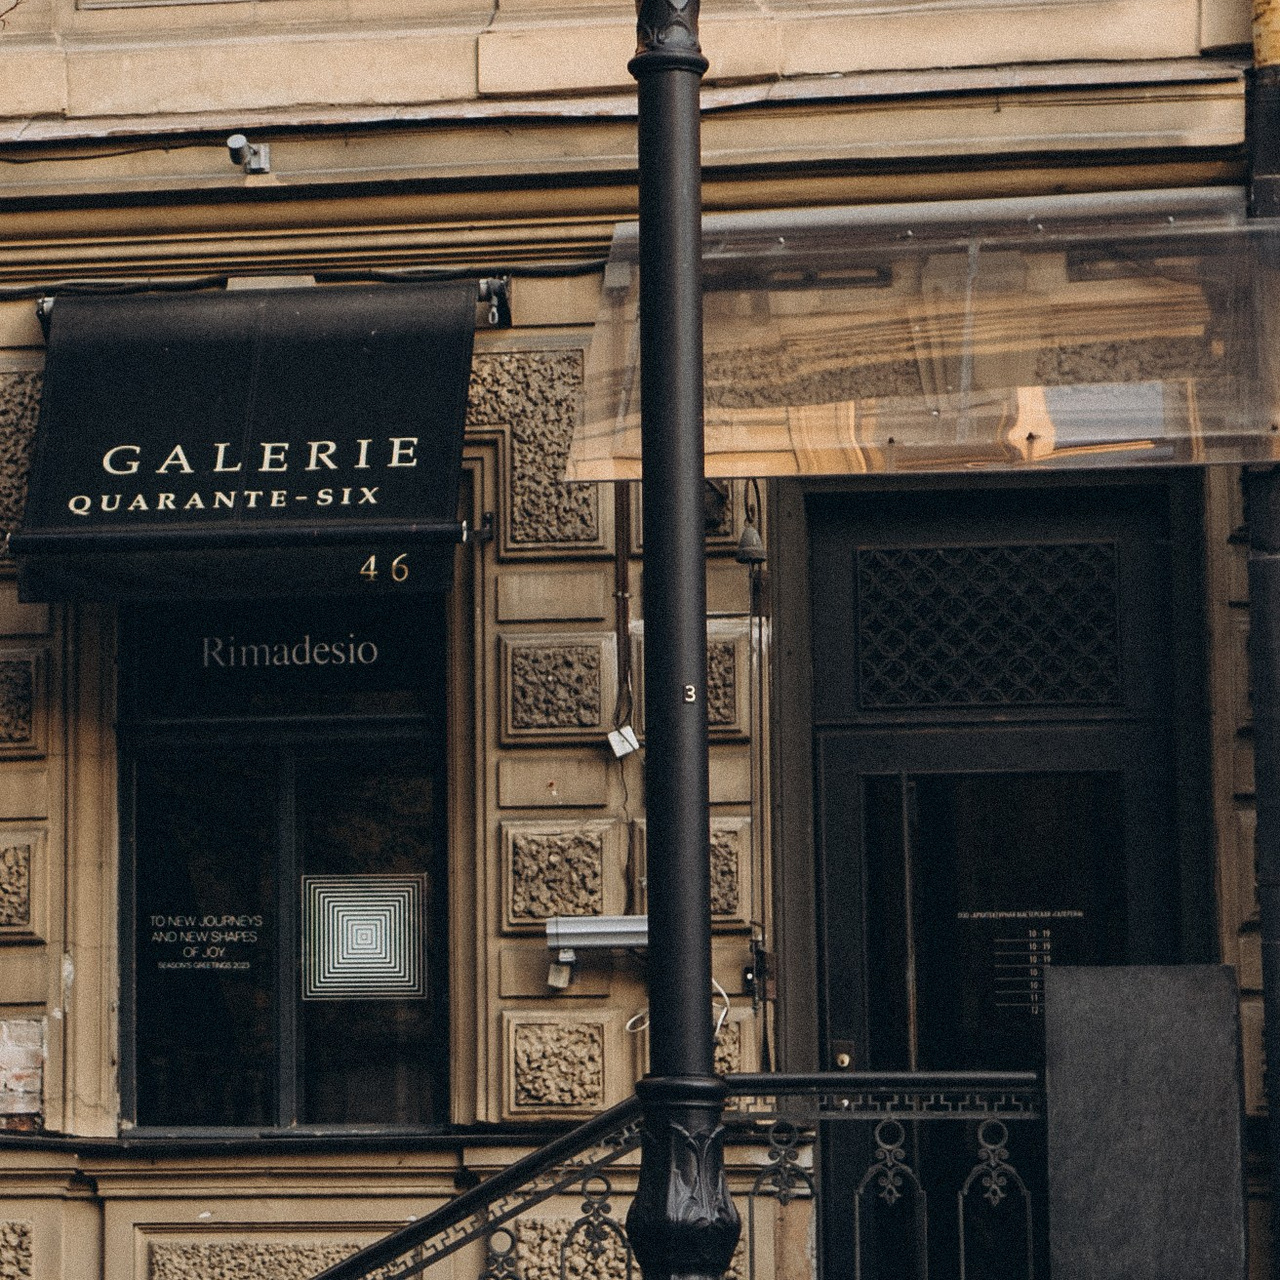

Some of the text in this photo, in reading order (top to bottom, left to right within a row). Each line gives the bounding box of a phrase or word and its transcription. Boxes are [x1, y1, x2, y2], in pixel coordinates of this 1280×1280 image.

[102, 437, 420, 475] GALERIE
[68, 487, 380, 516] QUARANTE-SIX
[360, 553, 410, 582] 46
[202, 632, 379, 668] Rimadesio
[685, 684, 696, 702] 3
[150, 915, 263, 927] TO NEW JOURNEYS
[151, 930, 258, 943] AND NEW SHAPES
[182, 946, 226, 958] OF JOY
